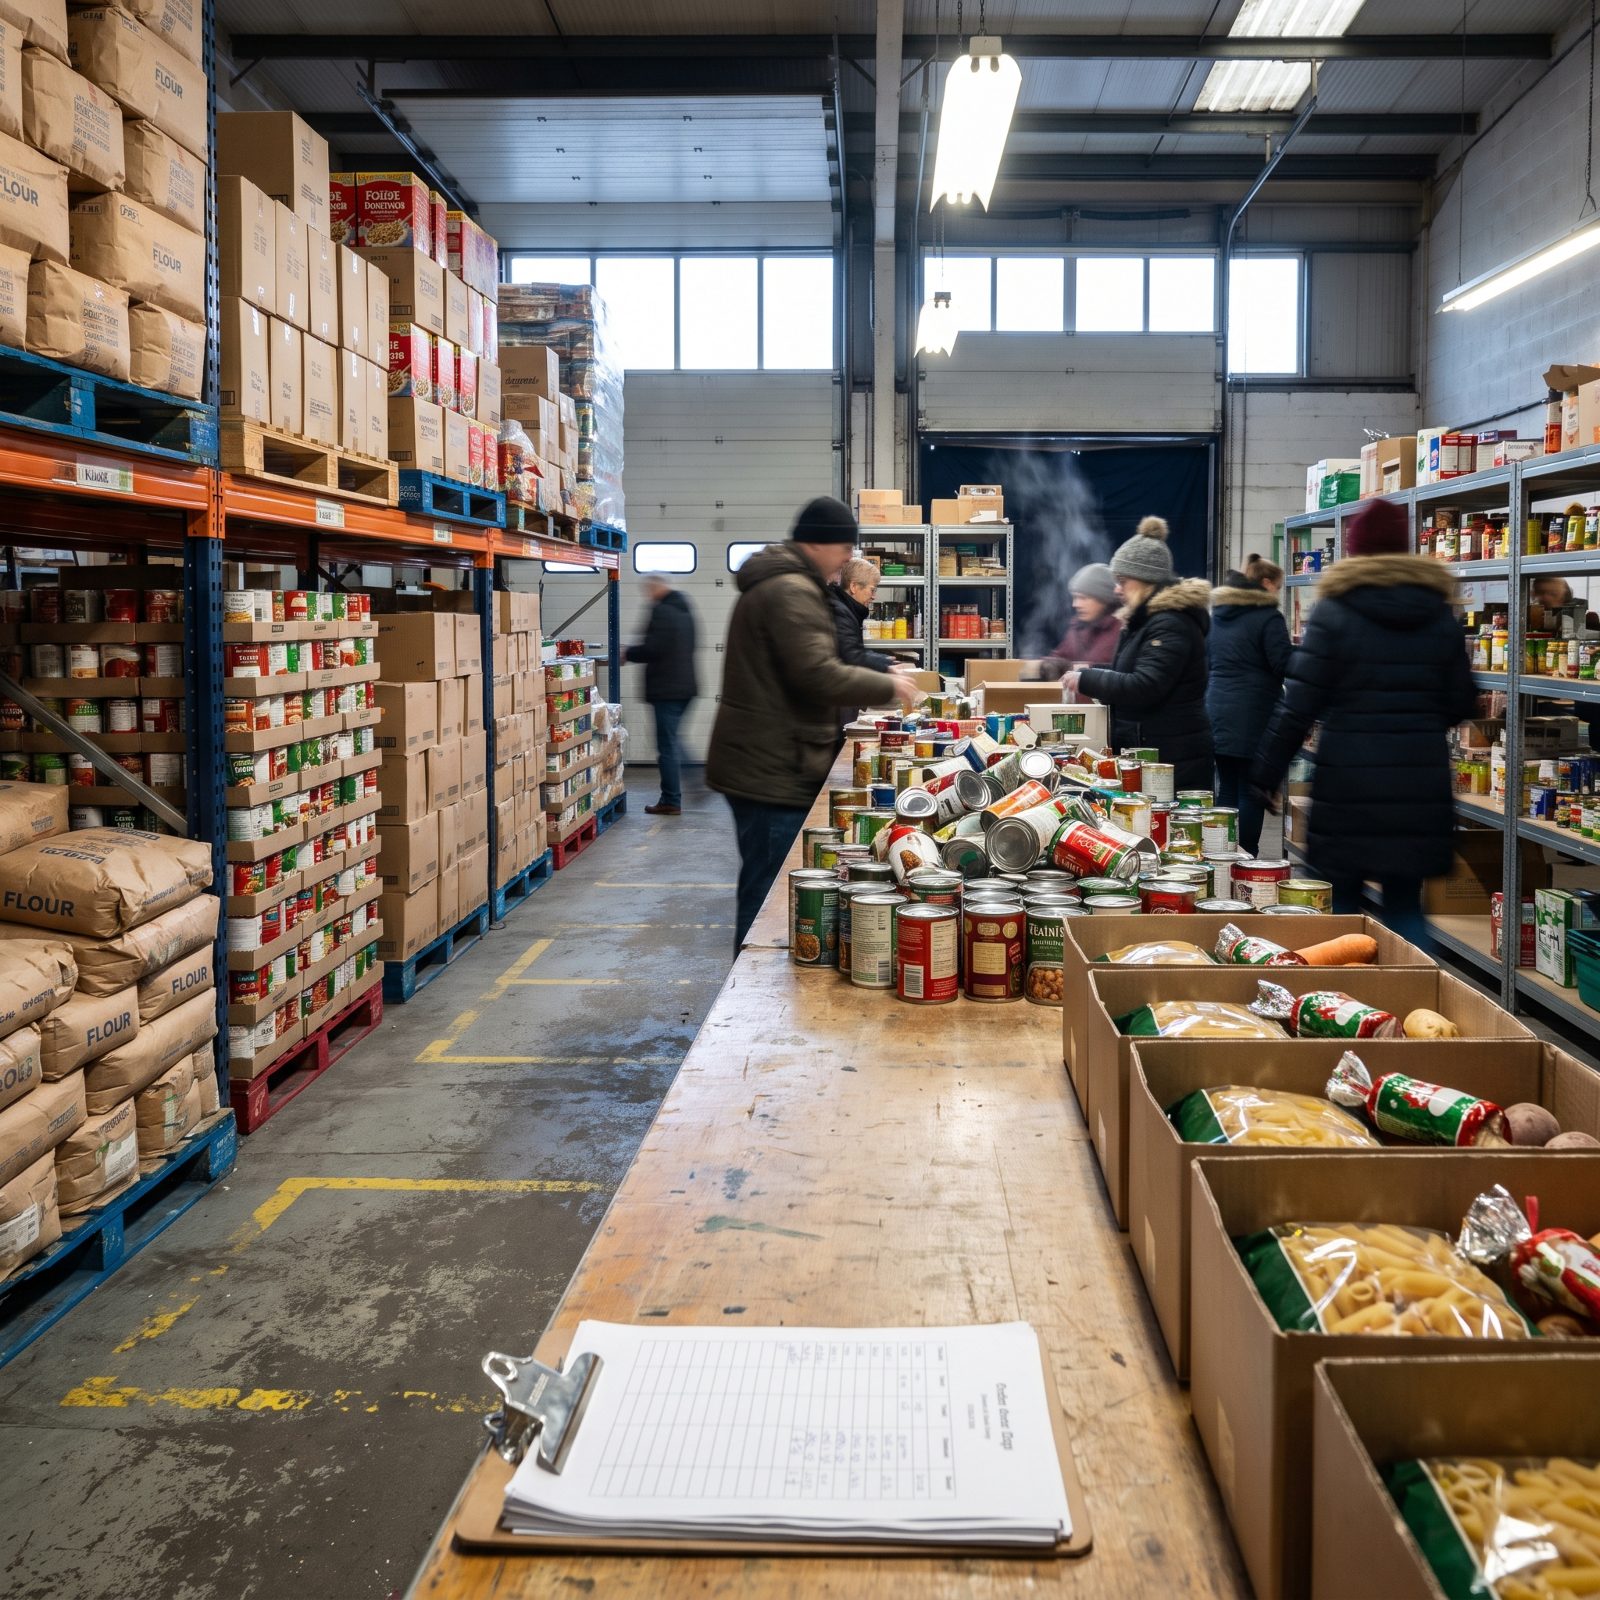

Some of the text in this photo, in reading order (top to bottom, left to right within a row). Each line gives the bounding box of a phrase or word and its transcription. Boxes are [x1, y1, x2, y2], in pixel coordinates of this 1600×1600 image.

[155, 67, 183, 99] FLOUR
[152, 247, 182, 273] FLOUR
[4, 891, 75, 917] FLOUR
[171, 966, 208, 995] FLOUR
[86, 1011, 131, 1047] FLOUR
